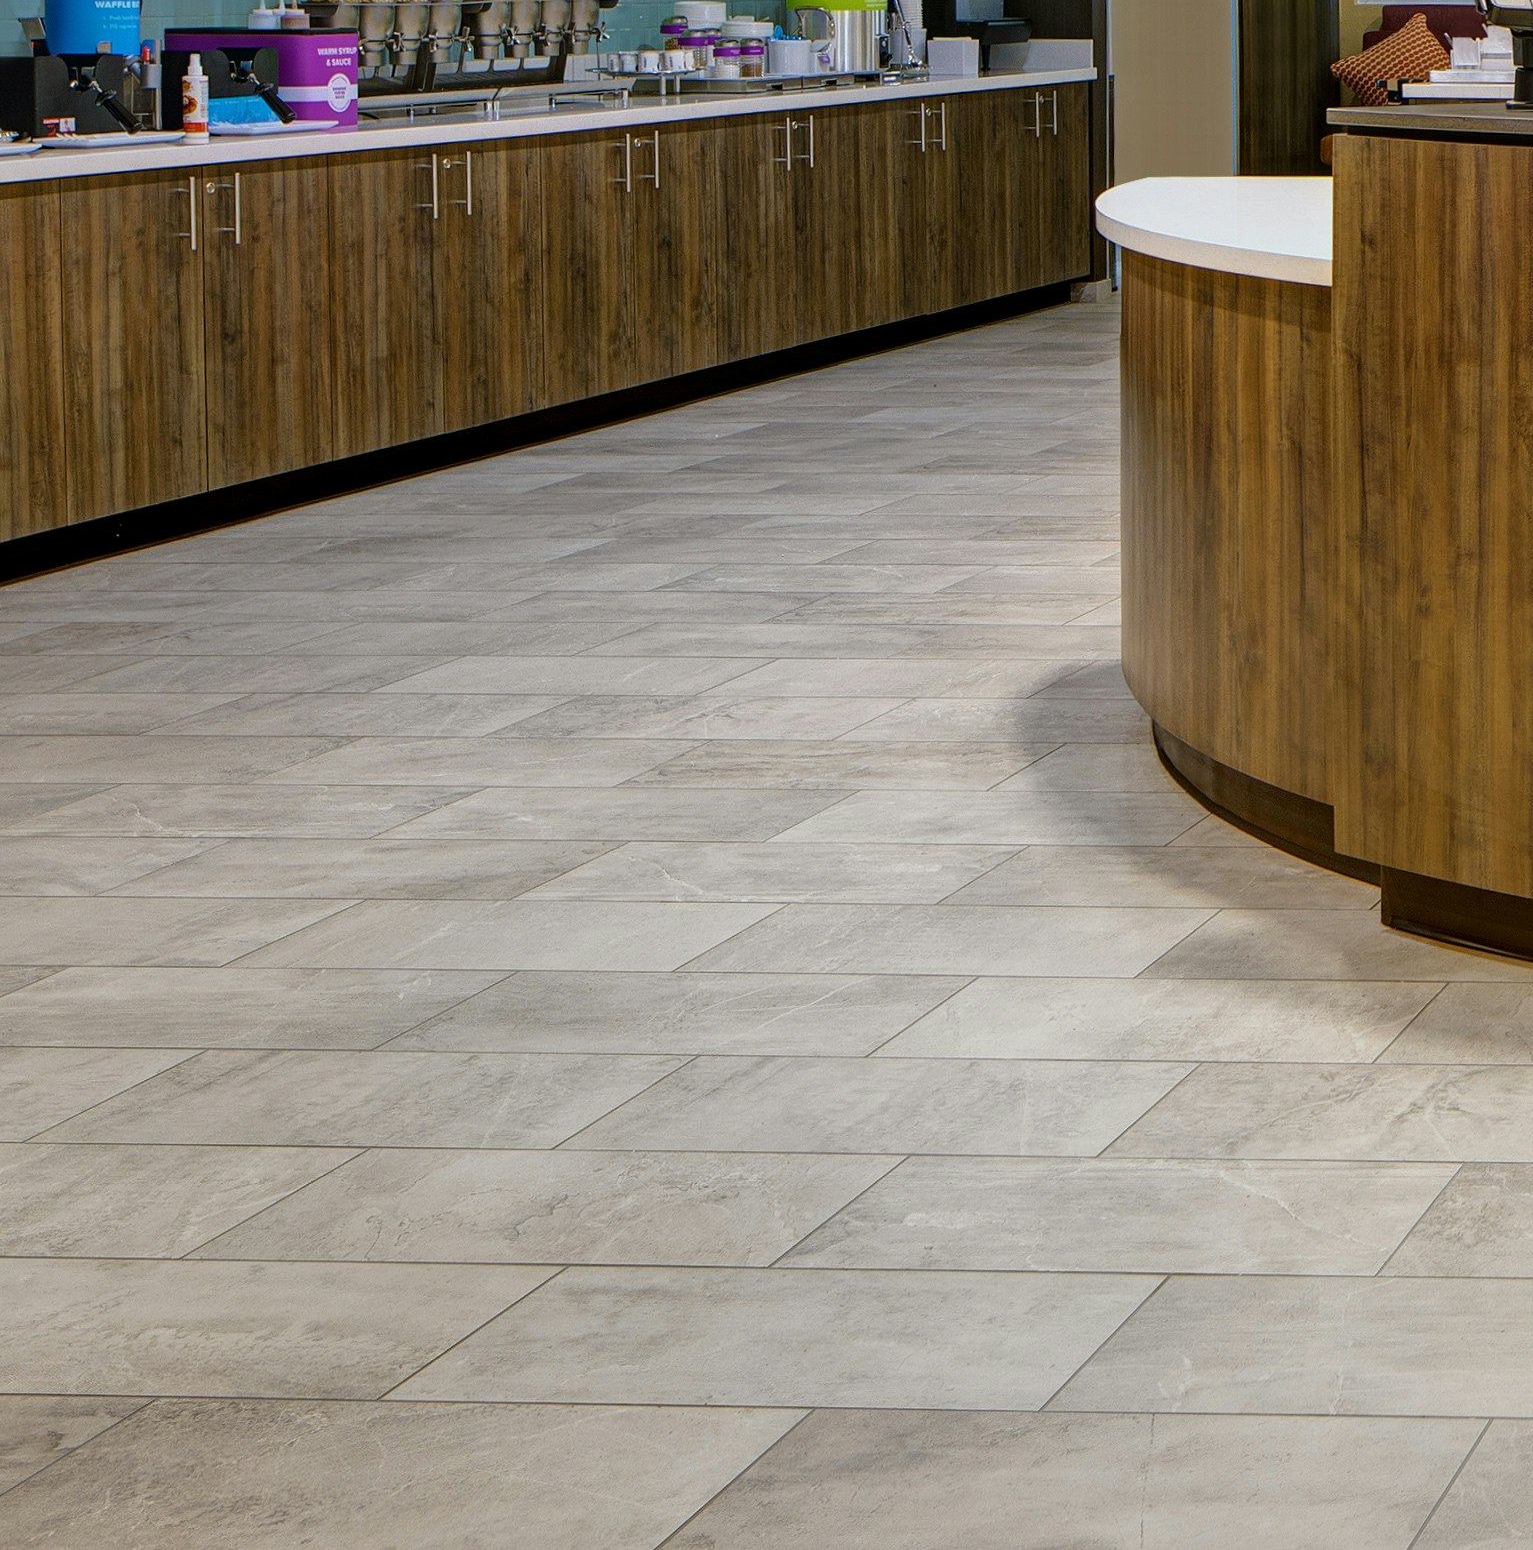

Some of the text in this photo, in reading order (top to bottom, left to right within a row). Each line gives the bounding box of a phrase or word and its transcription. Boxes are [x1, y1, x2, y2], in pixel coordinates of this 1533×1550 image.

[94, 1, 131, 9] WAFFLE
[317, 46, 358, 56] WARM SYRUP
[326, 58, 352, 67] & SAUCE
